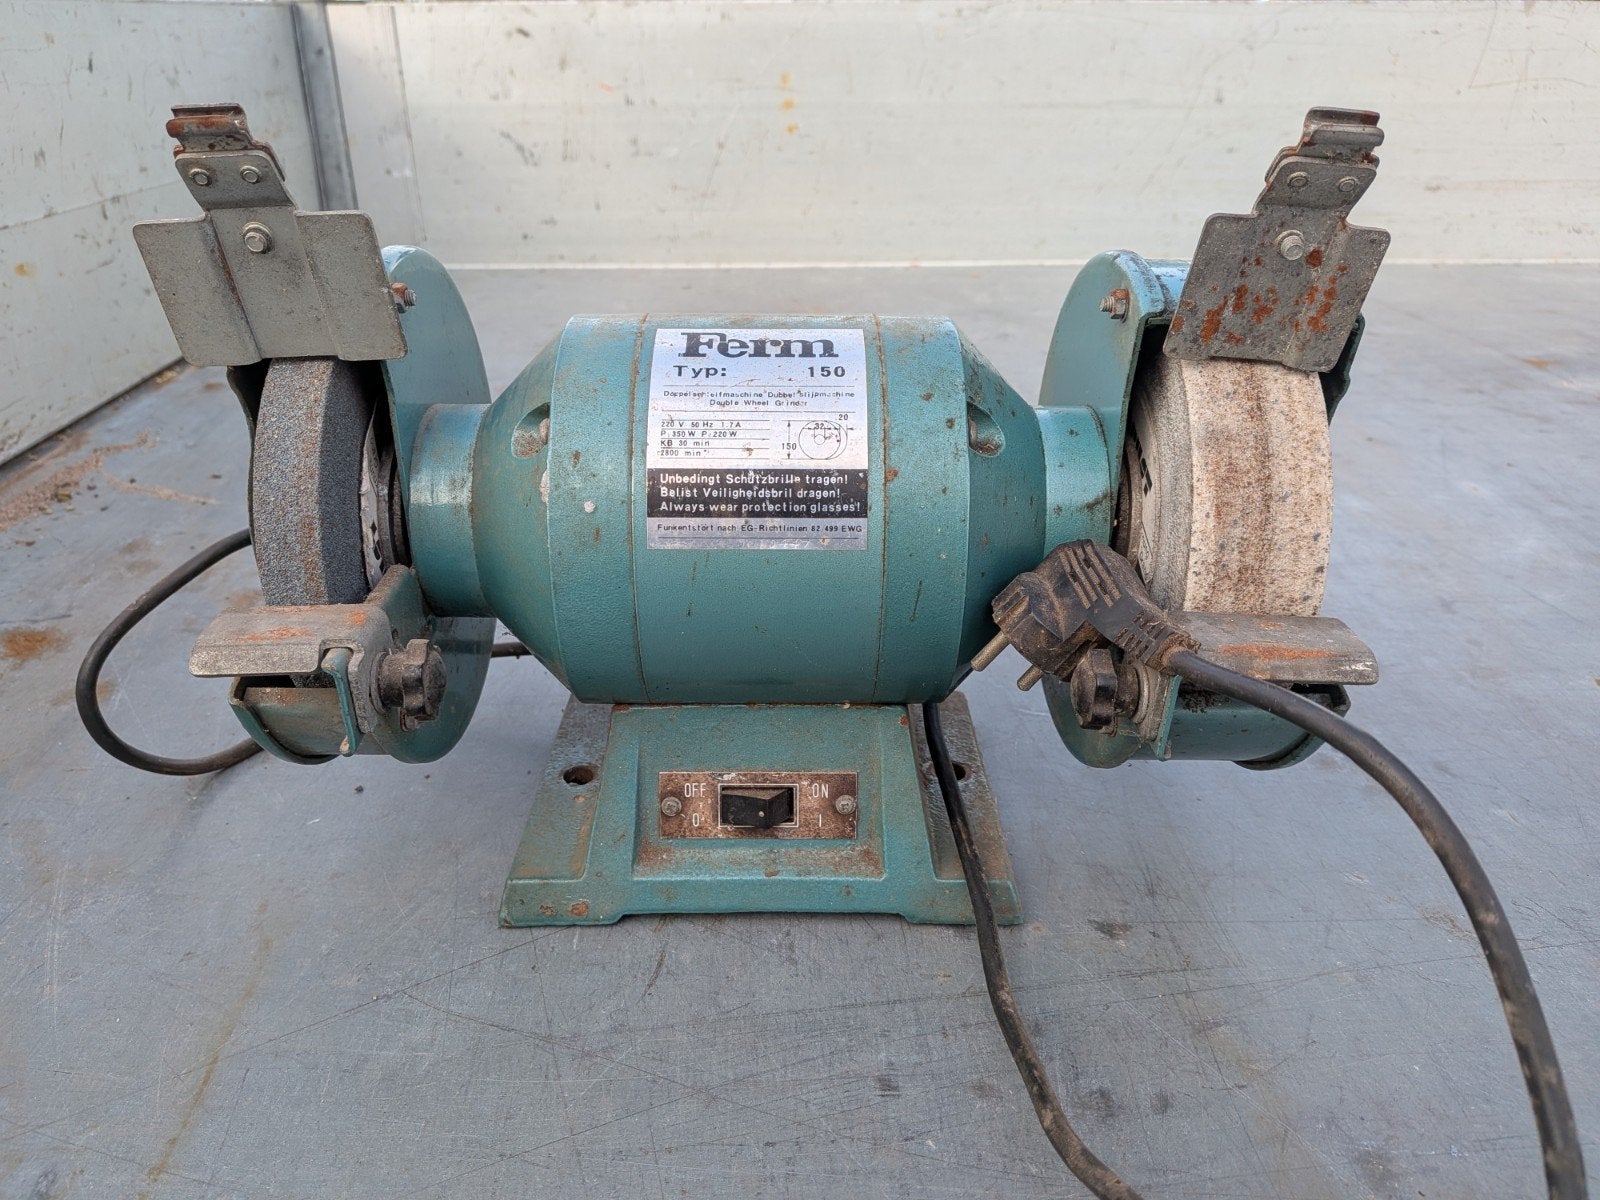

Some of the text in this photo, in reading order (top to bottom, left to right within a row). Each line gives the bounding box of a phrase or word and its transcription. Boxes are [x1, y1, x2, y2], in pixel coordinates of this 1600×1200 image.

[678, 332, 839, 358] Ferm
[673, 365, 846, 378] Typ: 150
[709, 399, 739, 407] Double
[743, 399, 769, 407] Wheel
[838, 413, 849, 421] 20
[814, 422, 825, 430] 32
[672, 430, 686, 438] 350
[688, 430, 697, 438] W
[714, 430, 727, 438] 220
[729, 430, 738, 438] W
[781, 442, 797, 450] 150
[660, 473, 848, 485] Unbedingt Schutzbrille tragen!
[703, 487, 792, 500] Veiligheidsbril
[797, 488, 841, 500] dragen!
[660, 501, 861, 514] Always wear protection glasses!
[717, 524, 737, 532] nach
[684, 783, 707, 798] OFF
[812, 783, 829, 799] ON
